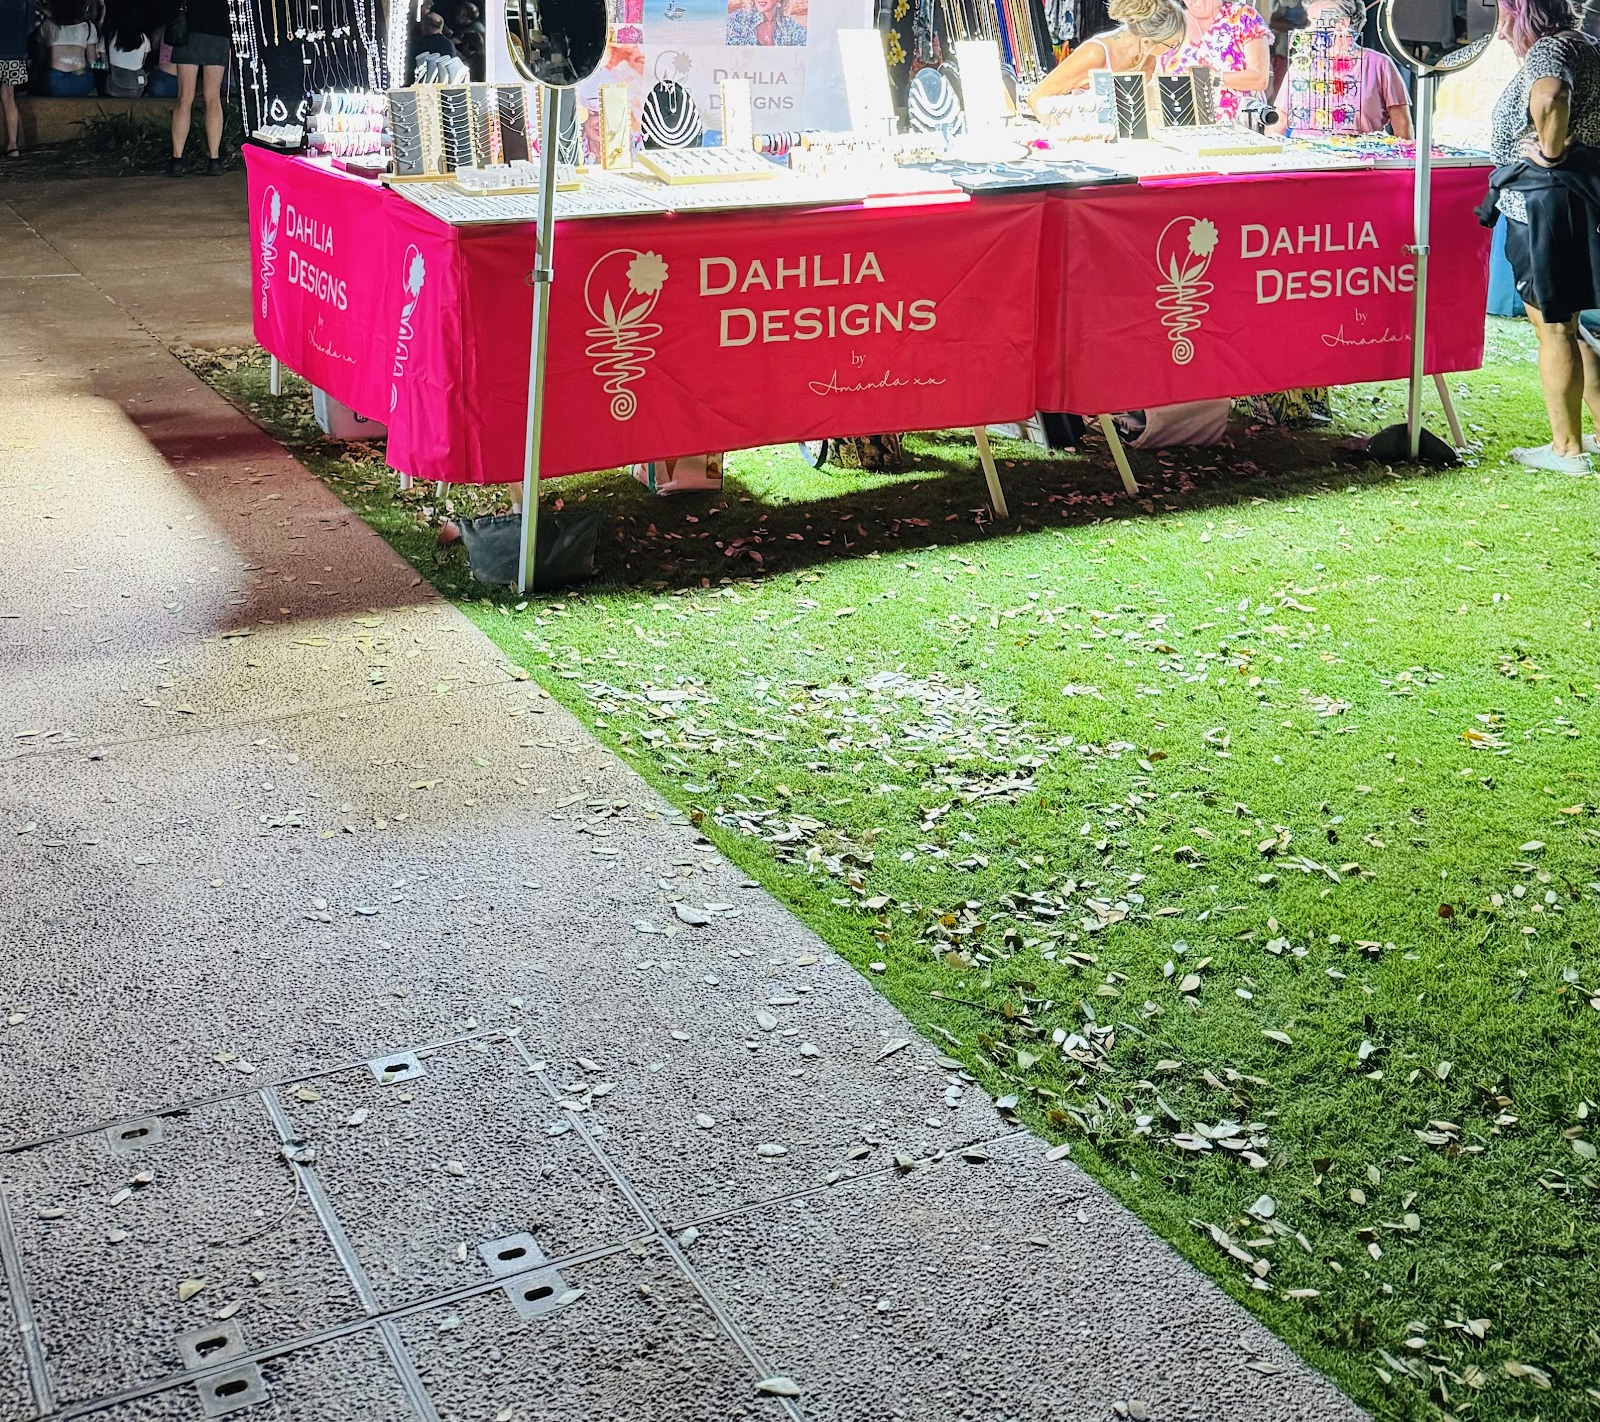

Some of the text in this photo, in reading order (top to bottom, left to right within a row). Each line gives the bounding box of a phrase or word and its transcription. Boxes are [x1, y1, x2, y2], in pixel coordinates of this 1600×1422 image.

[285, 204, 334, 257] DAHLIA
[1240, 220, 1380, 260] DAHLIA
[288, 249, 348, 311] DESIGNS
[699, 251, 885, 297] DAHLIA
[1255, 263, 1415, 305] DESIGNS
[719, 299, 938, 348] DESIGNS
[1321, 323, 1403, 347] Amanda
[1354, 307, 1368, 326] by
[851, 350, 866, 369] by
[808, 368, 947, 396] Amanda xx
